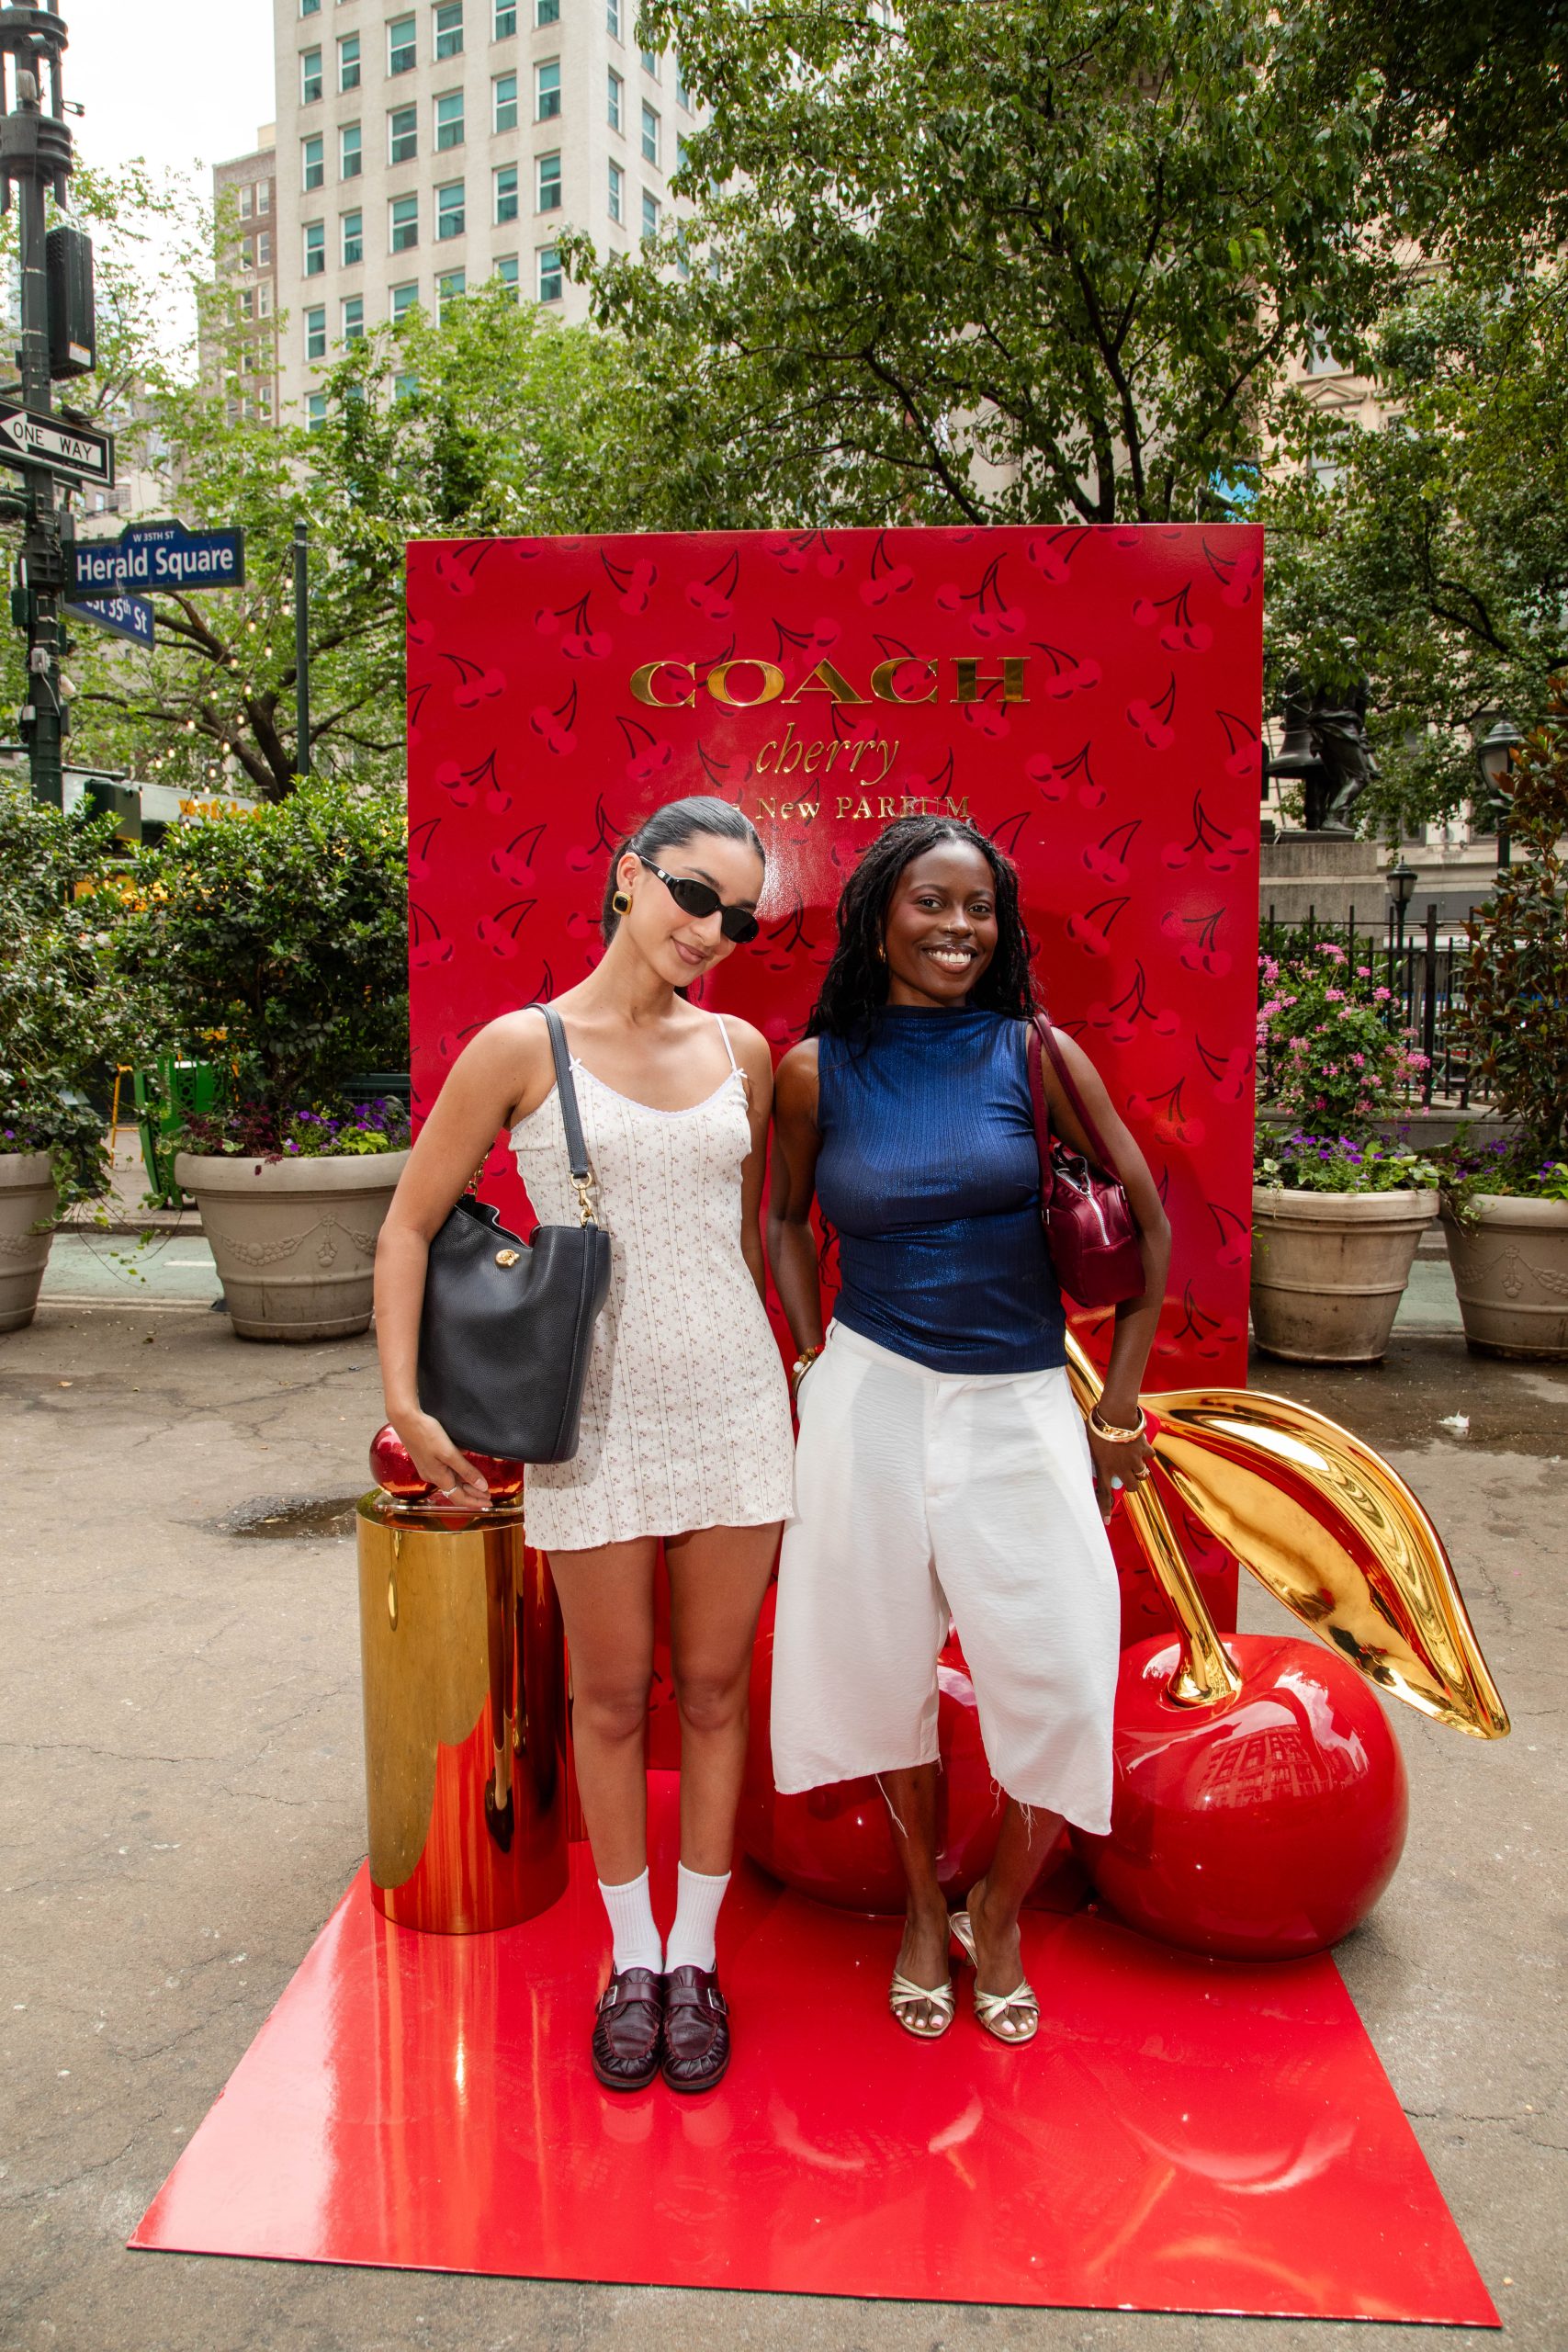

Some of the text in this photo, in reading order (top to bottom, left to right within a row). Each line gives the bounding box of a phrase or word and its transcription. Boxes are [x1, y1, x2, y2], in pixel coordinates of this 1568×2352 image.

[13, 421, 92, 461] ONE WAY
[132, 530, 175, 543] W 35TH ST
[76, 546, 234, 582] Herald Square
[107, 597, 131, 622] 35th
[133, 605, 148, 634] St
[629, 656, 1032, 708] COACH
[755, 721, 900, 786] cherry
[755, 797, 820, 820] New
[835, 795, 970, 820] PARFUM
